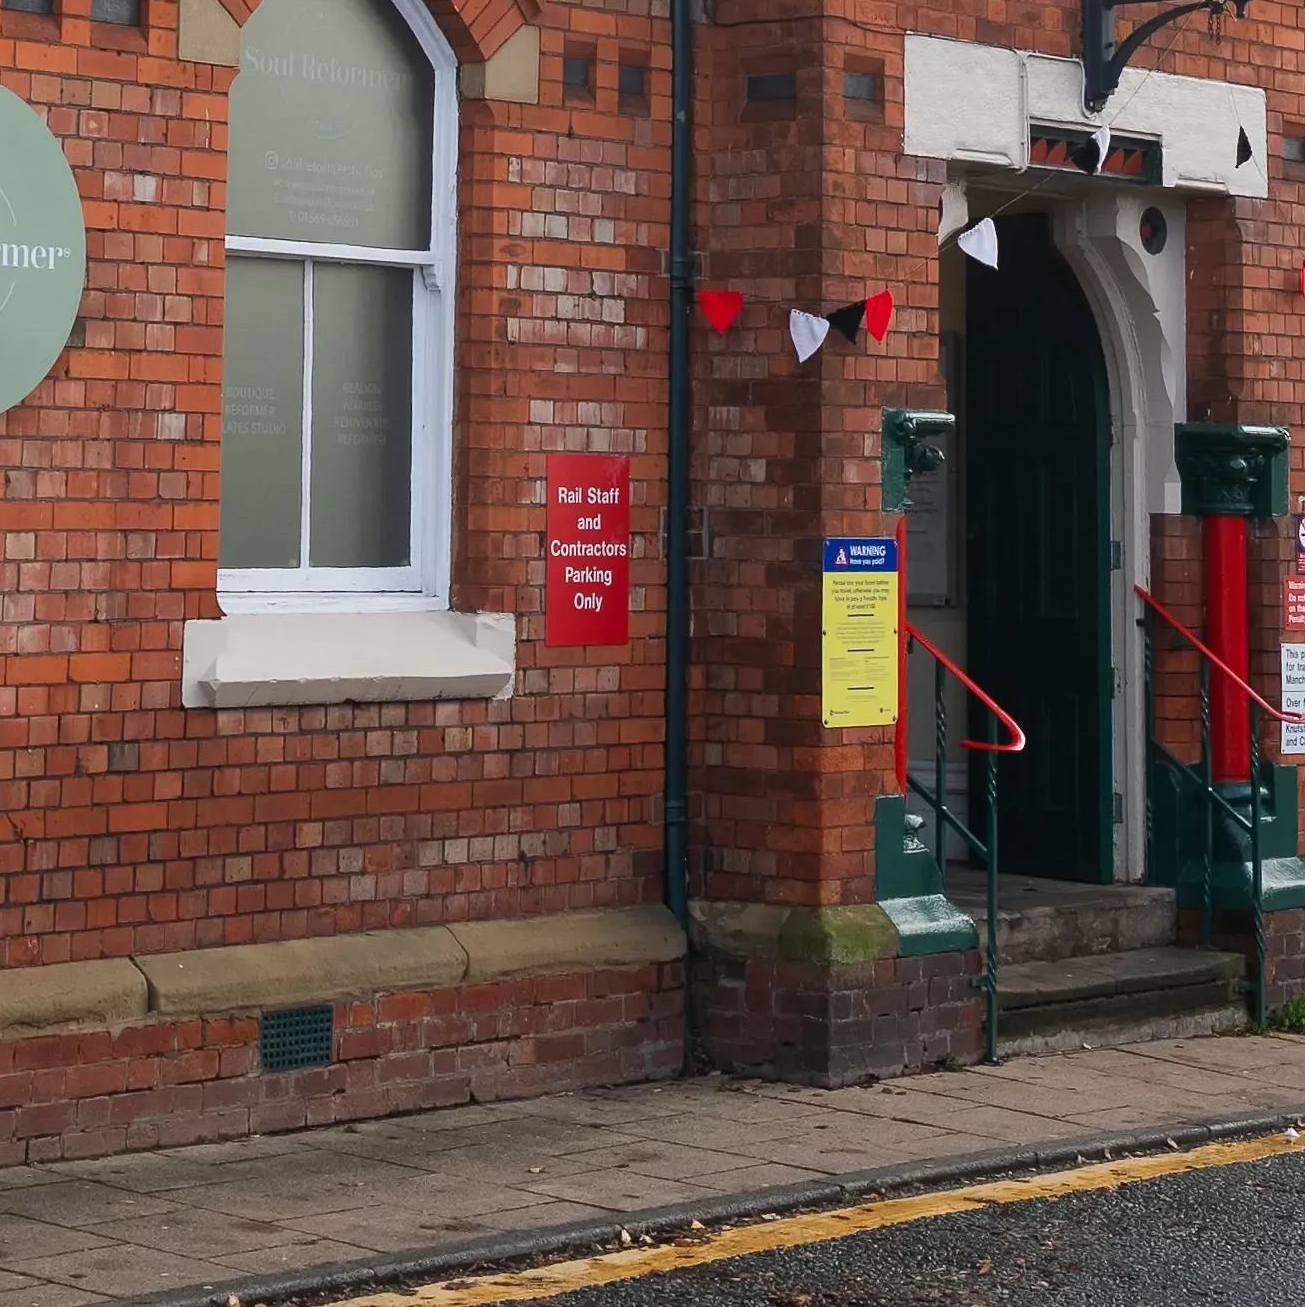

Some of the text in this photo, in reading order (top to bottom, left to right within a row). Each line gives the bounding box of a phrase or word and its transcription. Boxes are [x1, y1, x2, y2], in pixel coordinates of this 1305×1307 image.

[244, 45, 295, 79] Soul
[226, 386, 276, 401] BOUTIQUE
[251, 421, 288, 435] STUDIO
[558, 487, 620, 504] Rail Staff
[577, 514, 601, 530] and
[551, 540, 626, 557] Contractors
[850, 545, 886, 556] WARNING
[872, 558, 885, 566] paid?
[565, 567, 612, 586] Parking
[574, 593, 603, 612] Only
[1288, 605, 1296, 613] on
[1297, 604, 1305, 613] the
[1286, 648, 1299, 659] This
[1286, 662, 1295, 672] for
[1286, 697, 1301, 708] Over
[1286, 737, 1297, 746] and
